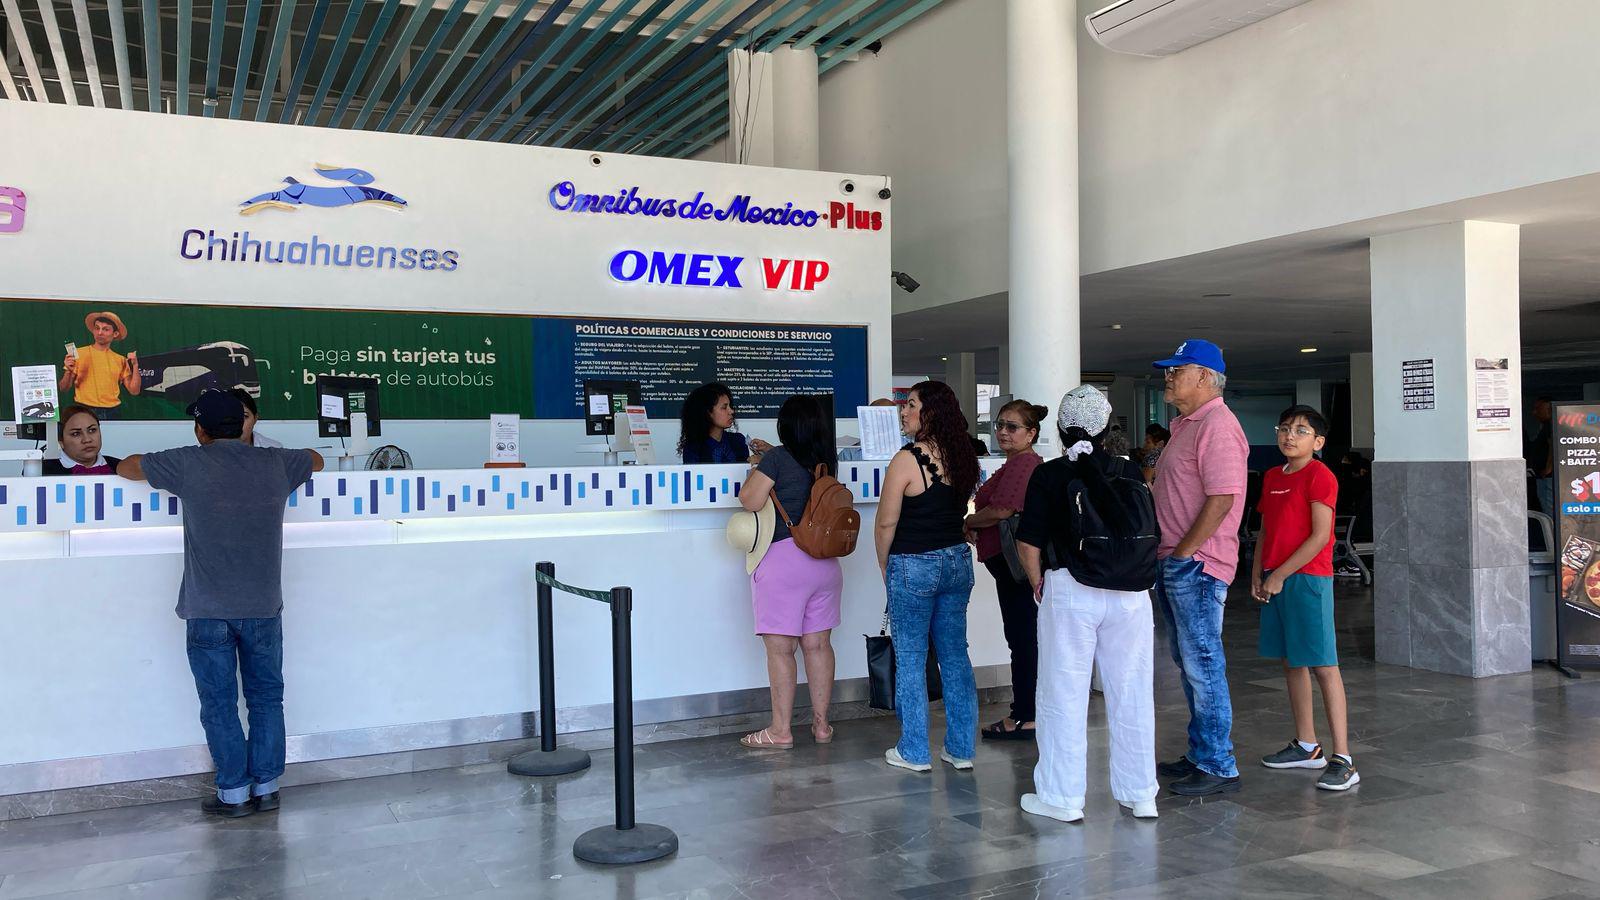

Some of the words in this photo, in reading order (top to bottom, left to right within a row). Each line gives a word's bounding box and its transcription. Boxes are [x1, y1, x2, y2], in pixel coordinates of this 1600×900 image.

[548, 181, 677, 217] Omnibus
[678, 191, 713, 220] de
[180, 228, 460, 272] Chihuahuenses
[609, 249, 744, 289] OMEX
[762, 257, 830, 291] VIP
[575, 322, 630, 335] POLÍTICAS
[630, 326, 700, 338] COMERCIALES
[701, 328, 708, 337] Y
[710, 328, 776, 340] CONDICIONES
[777, 330, 790, 340] DE
[790, 331, 833, 341] SERVICIO
[300, 346, 351, 366] Paga
[356, 345, 387, 363] sin
[392, 346, 460, 367] tarjeta
[464, 349, 496, 365] tus
[386, 370, 411, 387] de
[416, 371, 495, 387] autobús
[1559, 436, 1598, 445] COMBO
[1567, 449, 1598, 457] PIZZA
[1567, 458, 1597, 466] BAITZ
[1567, 504, 1587, 513] solo
